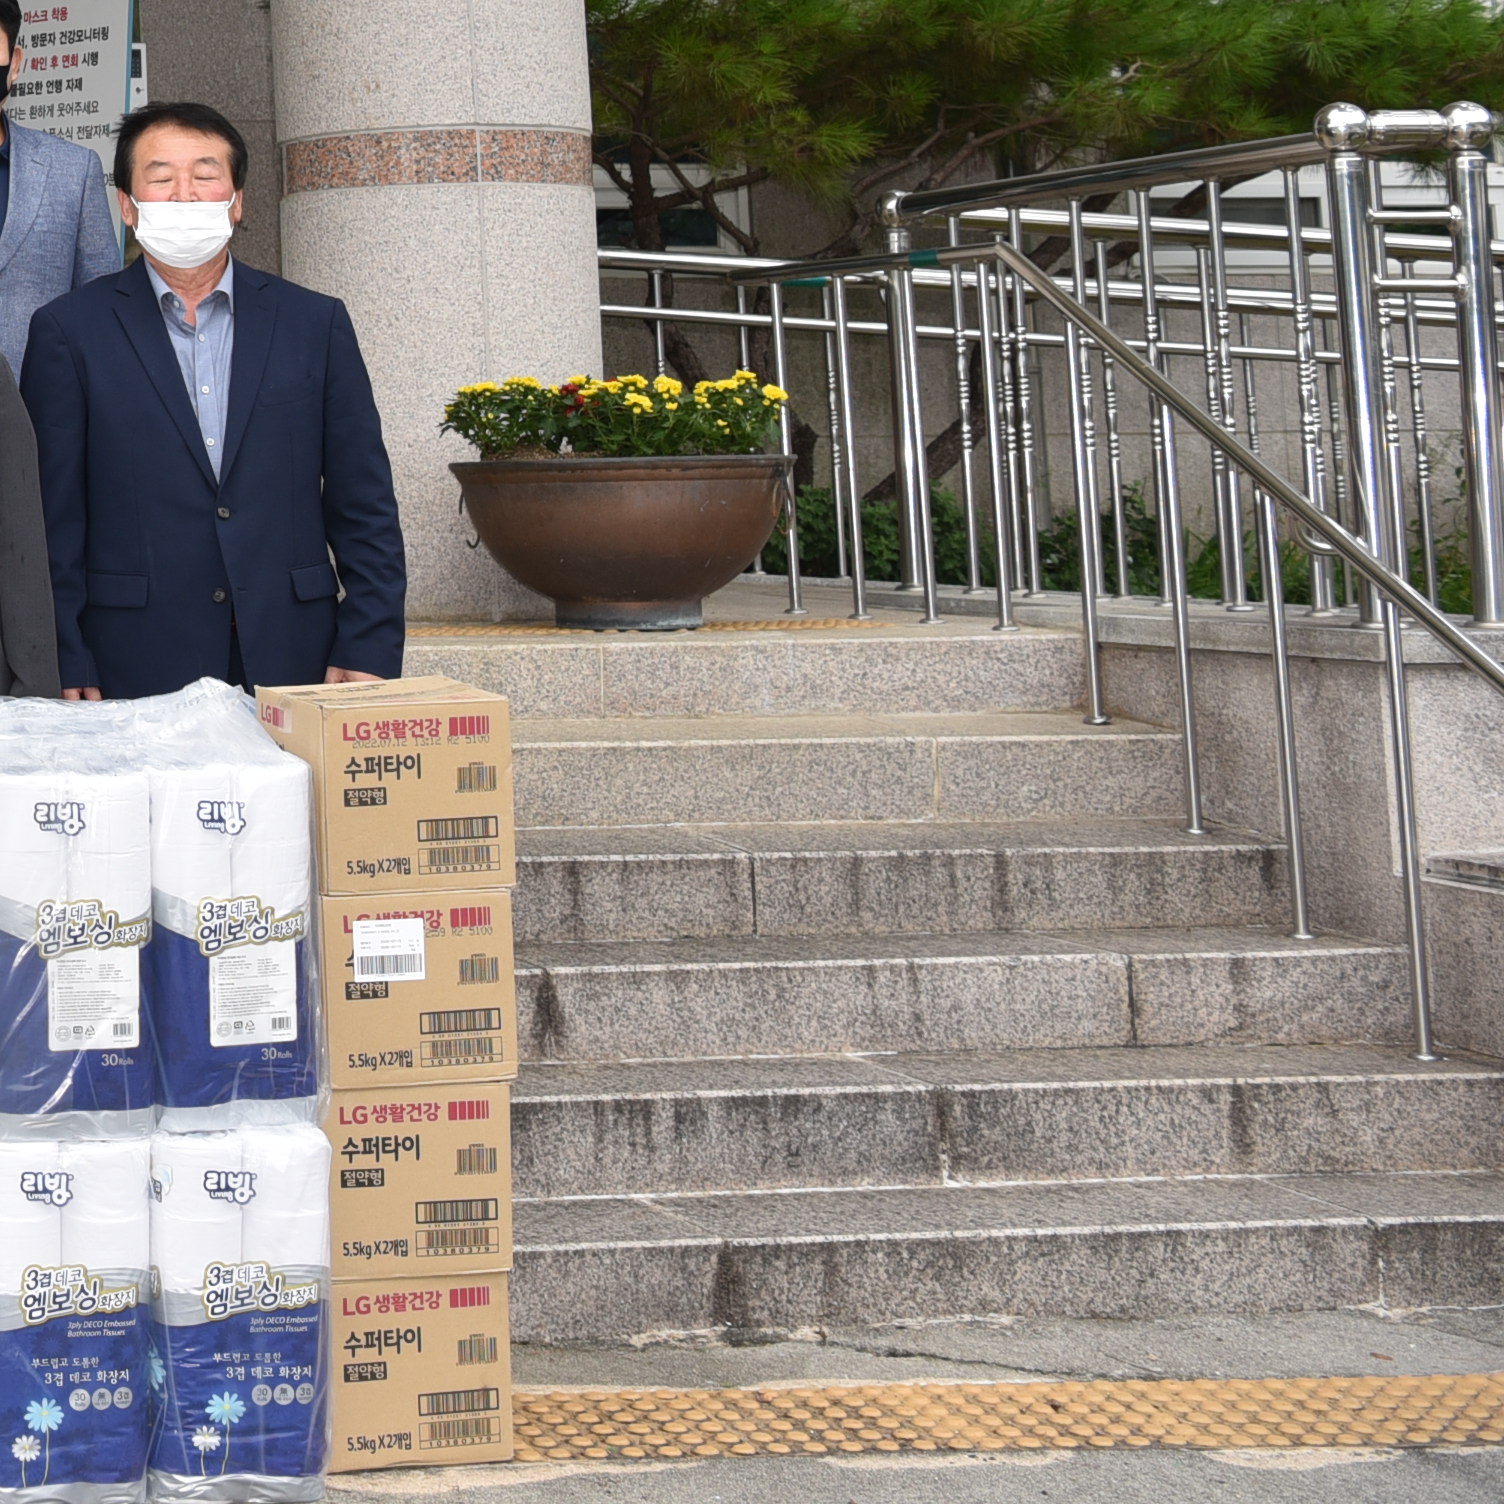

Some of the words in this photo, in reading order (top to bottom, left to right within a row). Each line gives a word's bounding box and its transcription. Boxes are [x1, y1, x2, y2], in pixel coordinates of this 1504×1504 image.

[23, 10, 48, 24] 마스크
[52, 7, 68, 22] 착용
[31, 33, 56, 47] 방문자
[59, 26, 109, 42] 건강모니터링
[31, 56, 47, 71] 확인
[50, 55, 59, 69] 후
[62, 54, 78, 69] 면회
[81, 52, 99, 66] 시행
[46, 79, 62, 94] 언행
[65, 77, 82, 92] 자제
[29, 104, 54, 119] 환하게
[57, 101, 99, 117] 웃어주세요
[76, 123, 110, 139] 전달자제
[343, 722, 371, 741] LG
[373, 718, 442, 739] 생활건강
[344, 753, 421, 782] 수퍼타이
[347, 789, 385, 806] 절약형
[347, 860, 375, 878] 5.5kg
[348, 981, 386, 999] 절약형
[348, 1053, 377, 1071] 5.5kg
[339, 1106, 368, 1125] LG
[371, 1103, 440, 1124] 생활건강
[341, 1134, 420, 1164] 수퍼타이
[344, 1171, 382, 1187] 절약형
[343, 1241, 371, 1260] 5.5kg
[343, 1296, 371, 1316] LG
[373, 1291, 442, 1314] 생활건강
[344, 1326, 422, 1358] 수퍼타이
[346, 1363, 385, 1381] 절약형
[347, 1436, 376, 1454] 5.5kg
